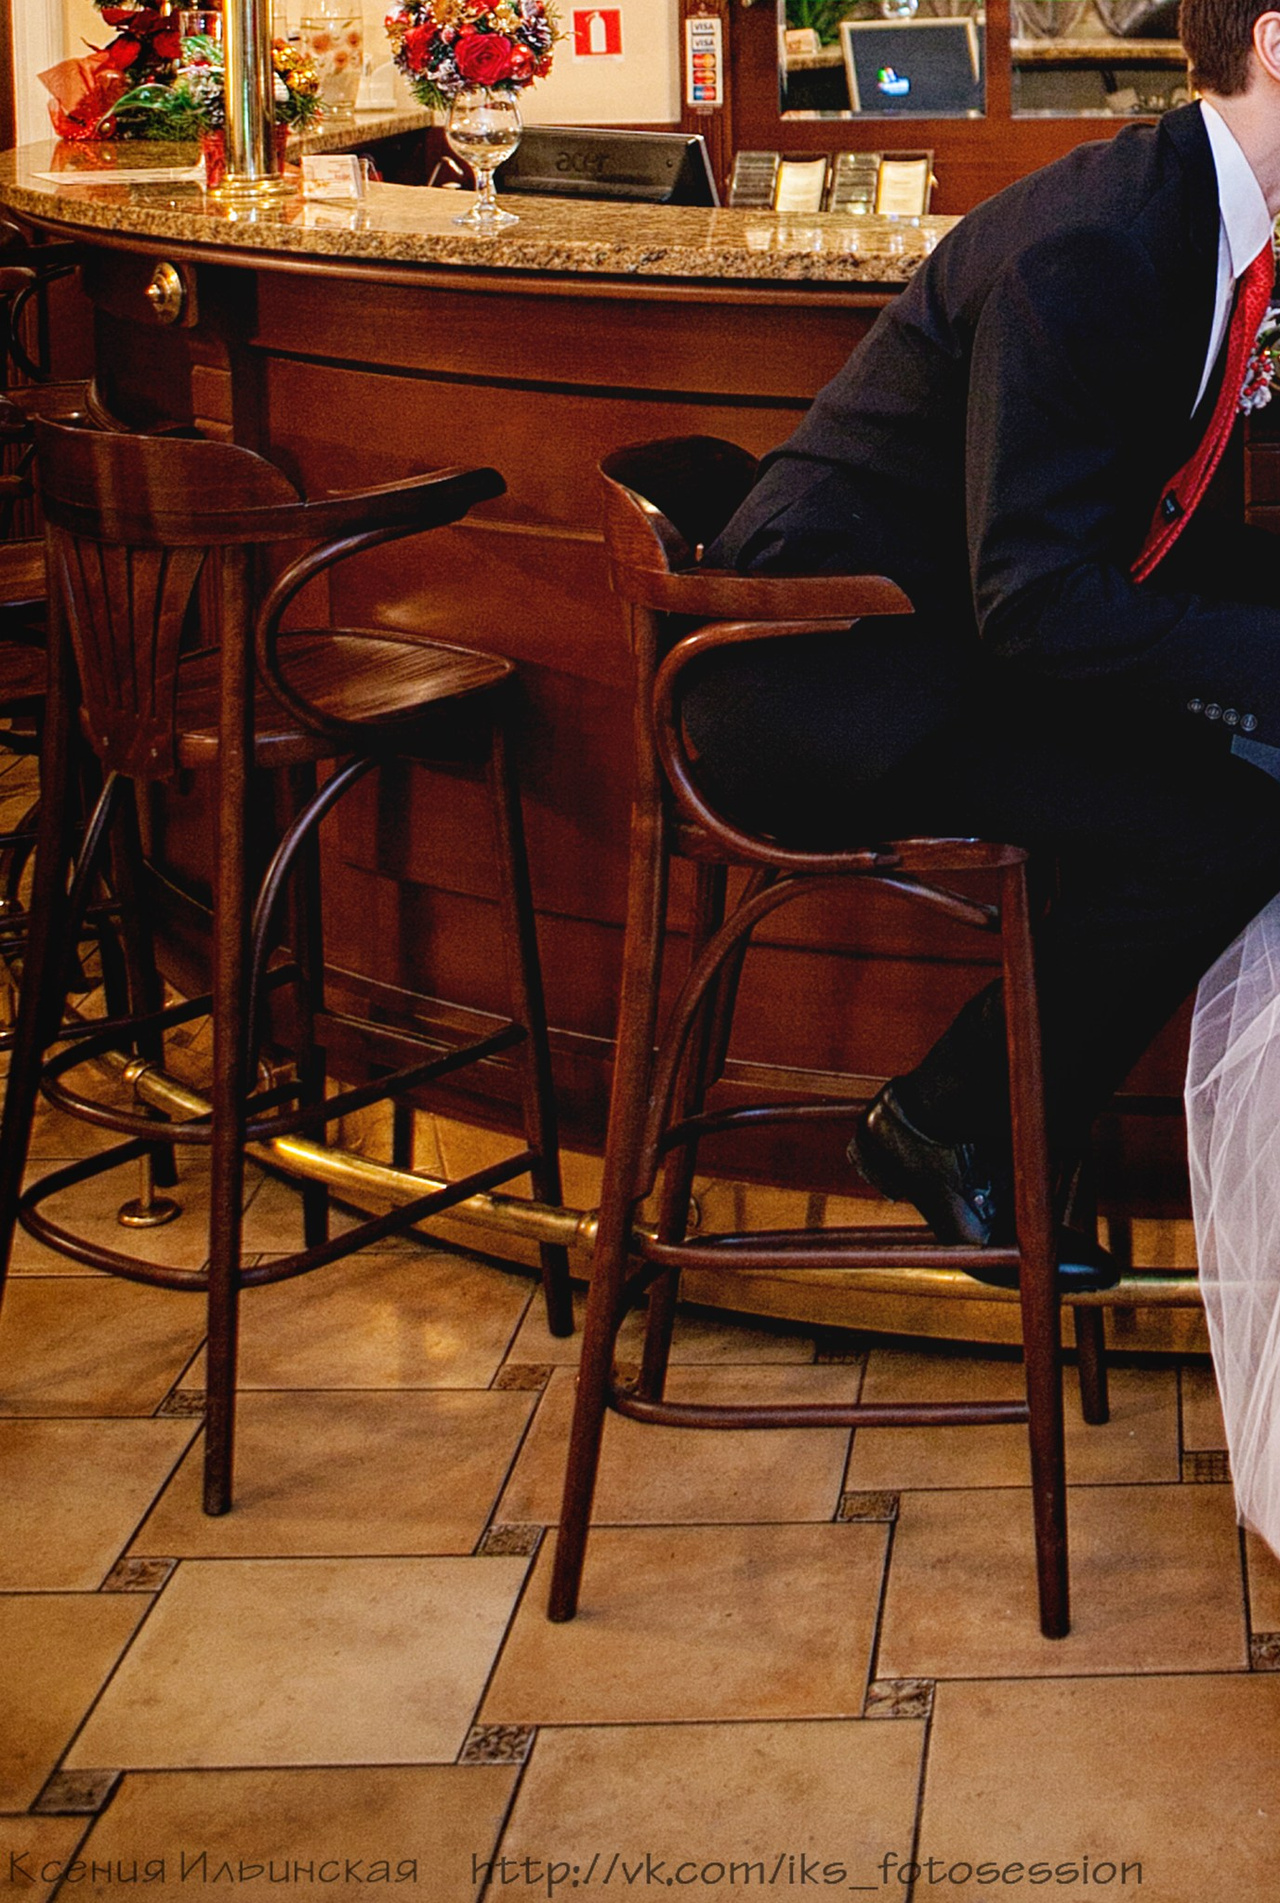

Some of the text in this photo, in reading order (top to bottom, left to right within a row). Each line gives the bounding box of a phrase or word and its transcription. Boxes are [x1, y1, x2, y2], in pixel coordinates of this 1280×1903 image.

[695, 22, 714, 30] VISA
[695, 38, 714, 46] VISA
[556, 151, 610, 173] acer
